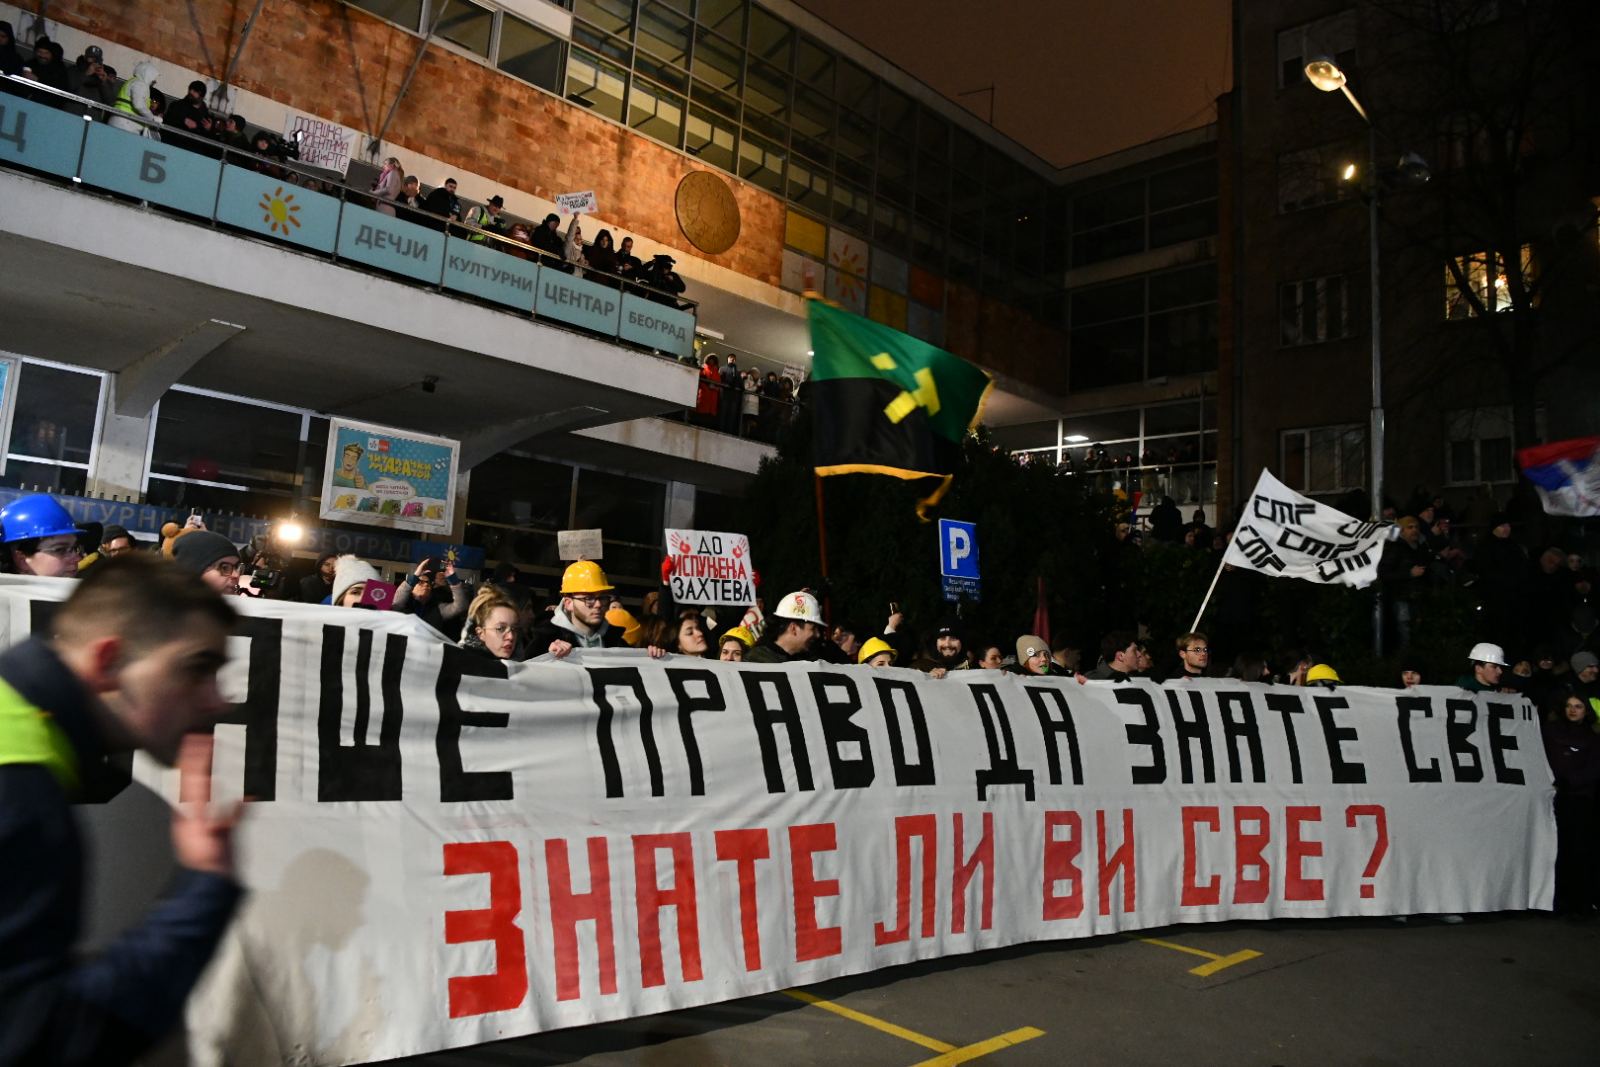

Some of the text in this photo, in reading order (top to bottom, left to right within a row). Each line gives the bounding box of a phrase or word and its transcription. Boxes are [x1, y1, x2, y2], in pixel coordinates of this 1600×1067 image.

[139, 150, 167, 184] Б
[354, 223, 687, 342] ДЕЧЈИ КУЛТУРНИ ЦЕНТАР БЕОГРАД
[697, 536, 723, 555] ДО
[948, 527, 971, 570] P
[671, 554, 748, 579] ИСПУЊЕЊА
[673, 577, 752, 602] ЗАХТЕВА
[585, 667, 937, 799] ПРАВО
[968, 683, 1085, 802] ДА
[1113, 687, 1368, 786] ЗНАТЕ
[443, 822, 844, 1020] ЗНАТЕ
[874, 812, 996, 947] ЛИ
[1043, 808, 1136, 921] ВИ
